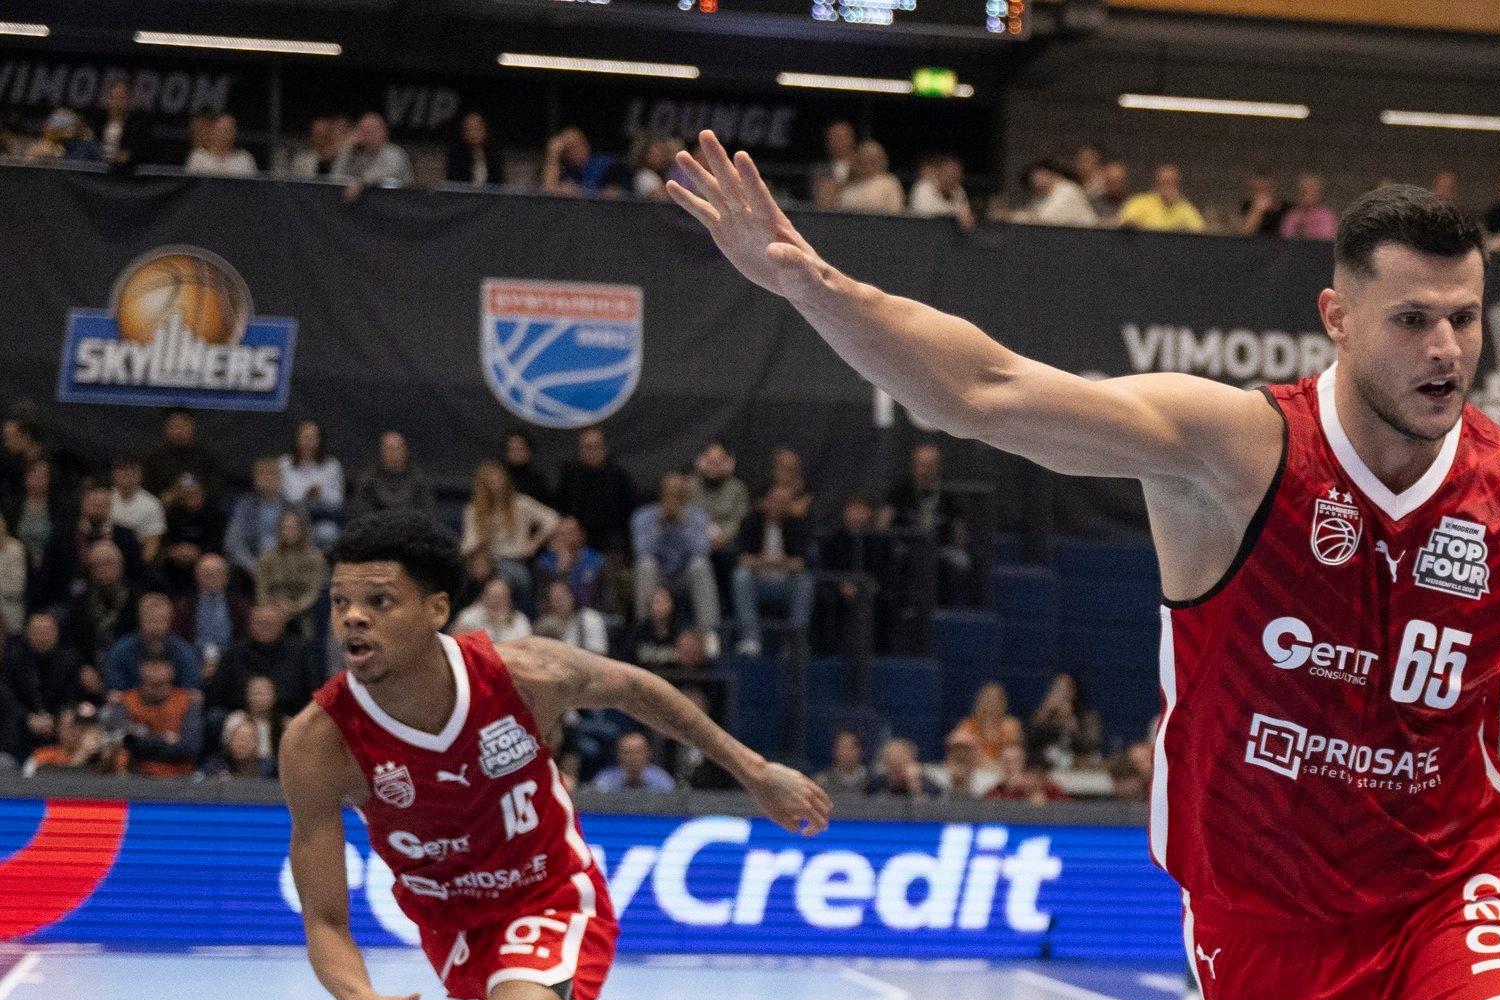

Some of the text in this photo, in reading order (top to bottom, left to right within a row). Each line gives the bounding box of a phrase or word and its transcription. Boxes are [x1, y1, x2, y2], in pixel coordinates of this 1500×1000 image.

[382, 85, 460, 130] VIP
[1435, 535, 1483, 562] TOP
[1419, 554, 1485, 586] FOUR
[1309, 666, 1368, 686] CONSULTING
[1390, 619, 1473, 710] 65
[483, 724, 526, 754] TOP
[485, 739, 538, 770] FOUR
[1304, 735, 1440, 780] PRIOSAFE
[1302, 764, 1354, 785] safety
[1357, 772, 1403, 791] starts
